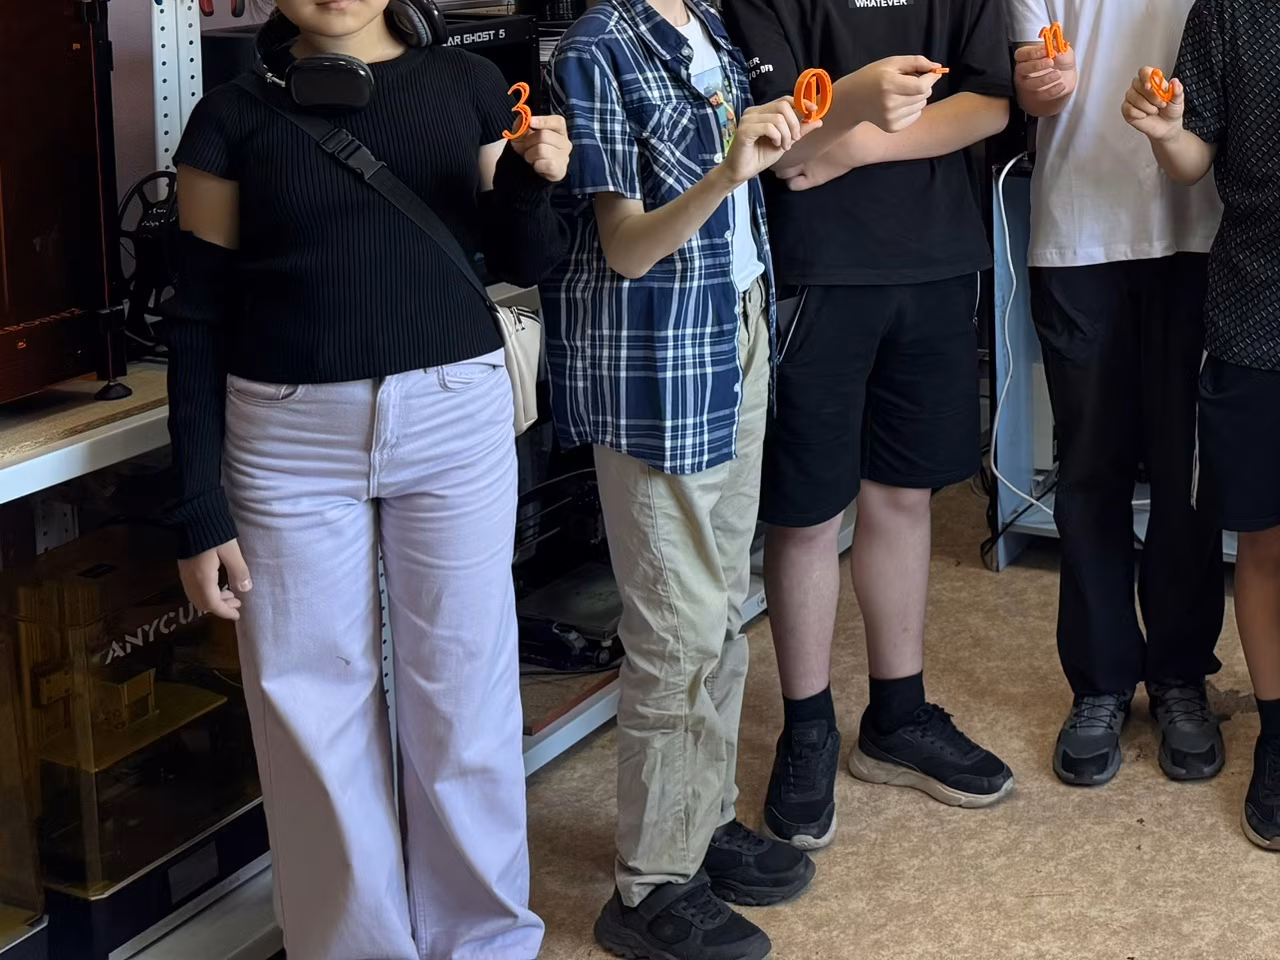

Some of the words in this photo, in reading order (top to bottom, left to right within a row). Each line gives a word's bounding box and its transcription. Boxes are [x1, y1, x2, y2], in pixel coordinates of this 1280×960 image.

[463, 30, 495, 44] GHOST
[498, 29, 506, 38] 5
[502, 81, 532, 140] 3
